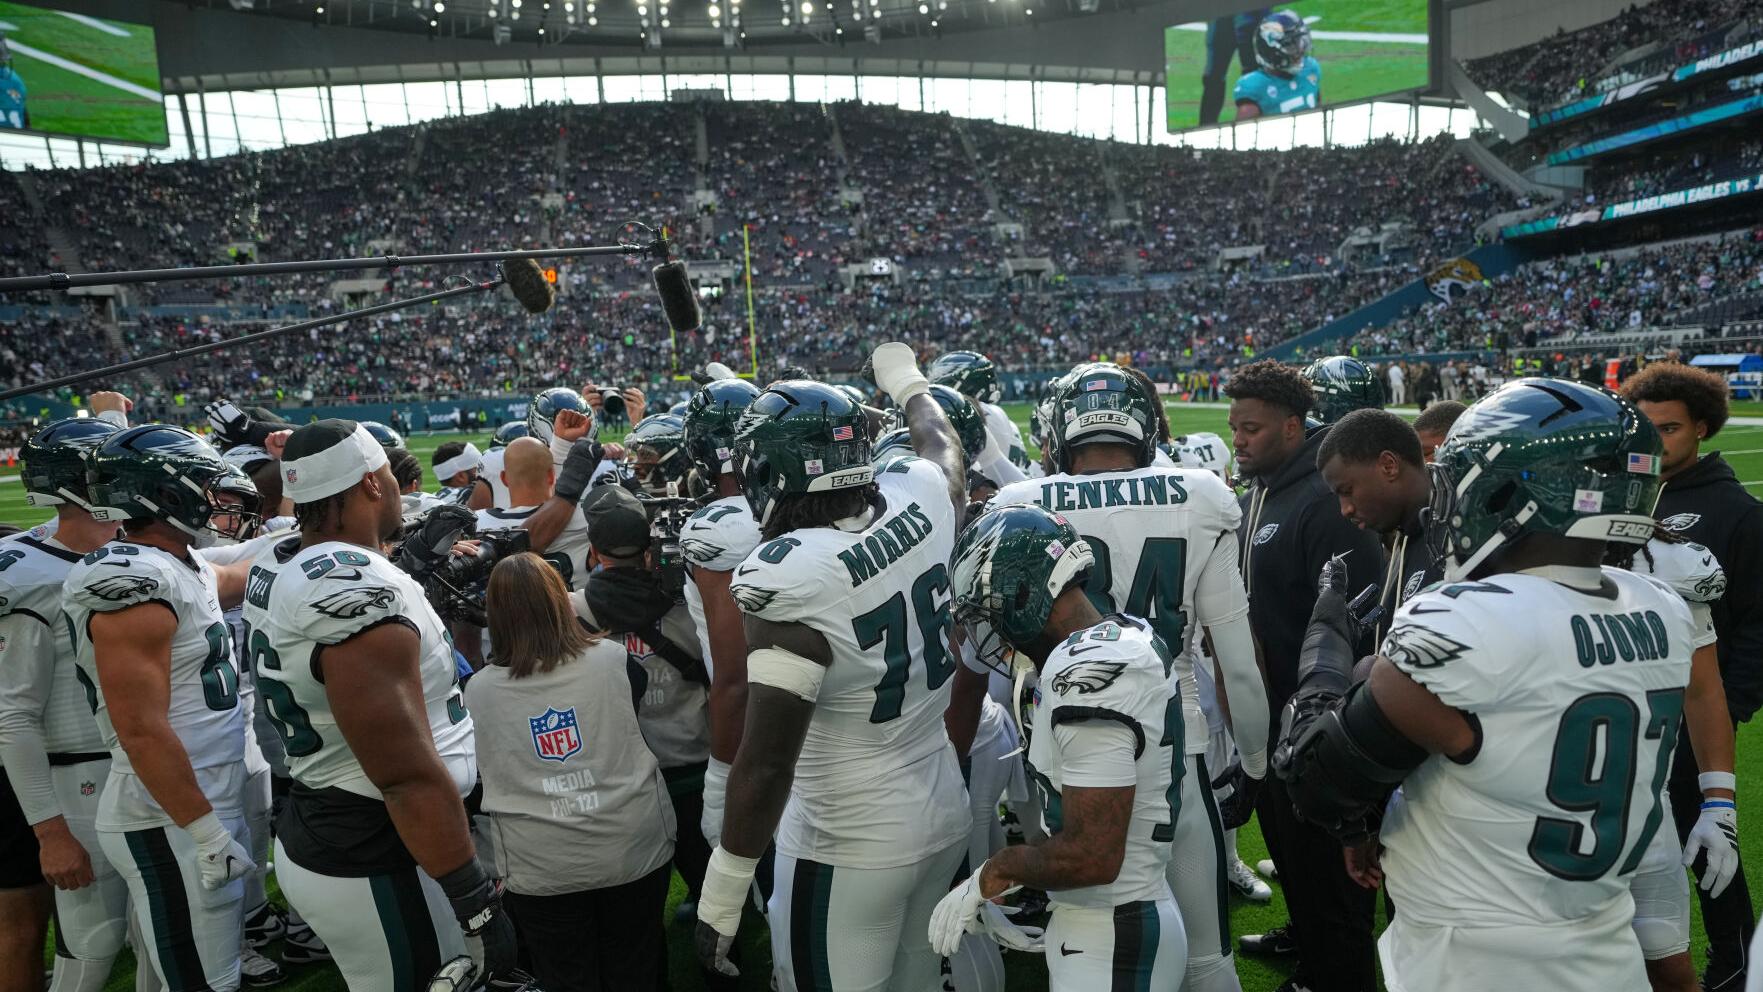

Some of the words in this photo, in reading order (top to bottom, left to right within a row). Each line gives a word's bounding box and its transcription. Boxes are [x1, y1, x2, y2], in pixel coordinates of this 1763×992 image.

[1613, 191, 1686, 218] PHILADELPHIA
[1687, 180, 1730, 204] EAGLES
[1080, 413, 1131, 427] EAGLES
[1034, 474, 1188, 511] JENKINS
[836, 501, 934, 588] MORRIS
[851, 562, 957, 724] 76
[1570, 610, 1670, 668] OJOMO
[537, 727, 578, 756] NFL
[541, 768, 596, 795] MEDIA
[1527, 686, 1686, 882] 97
[549, 791, 600, 819] PHI-127
[468, 906, 493, 931] NIKE
